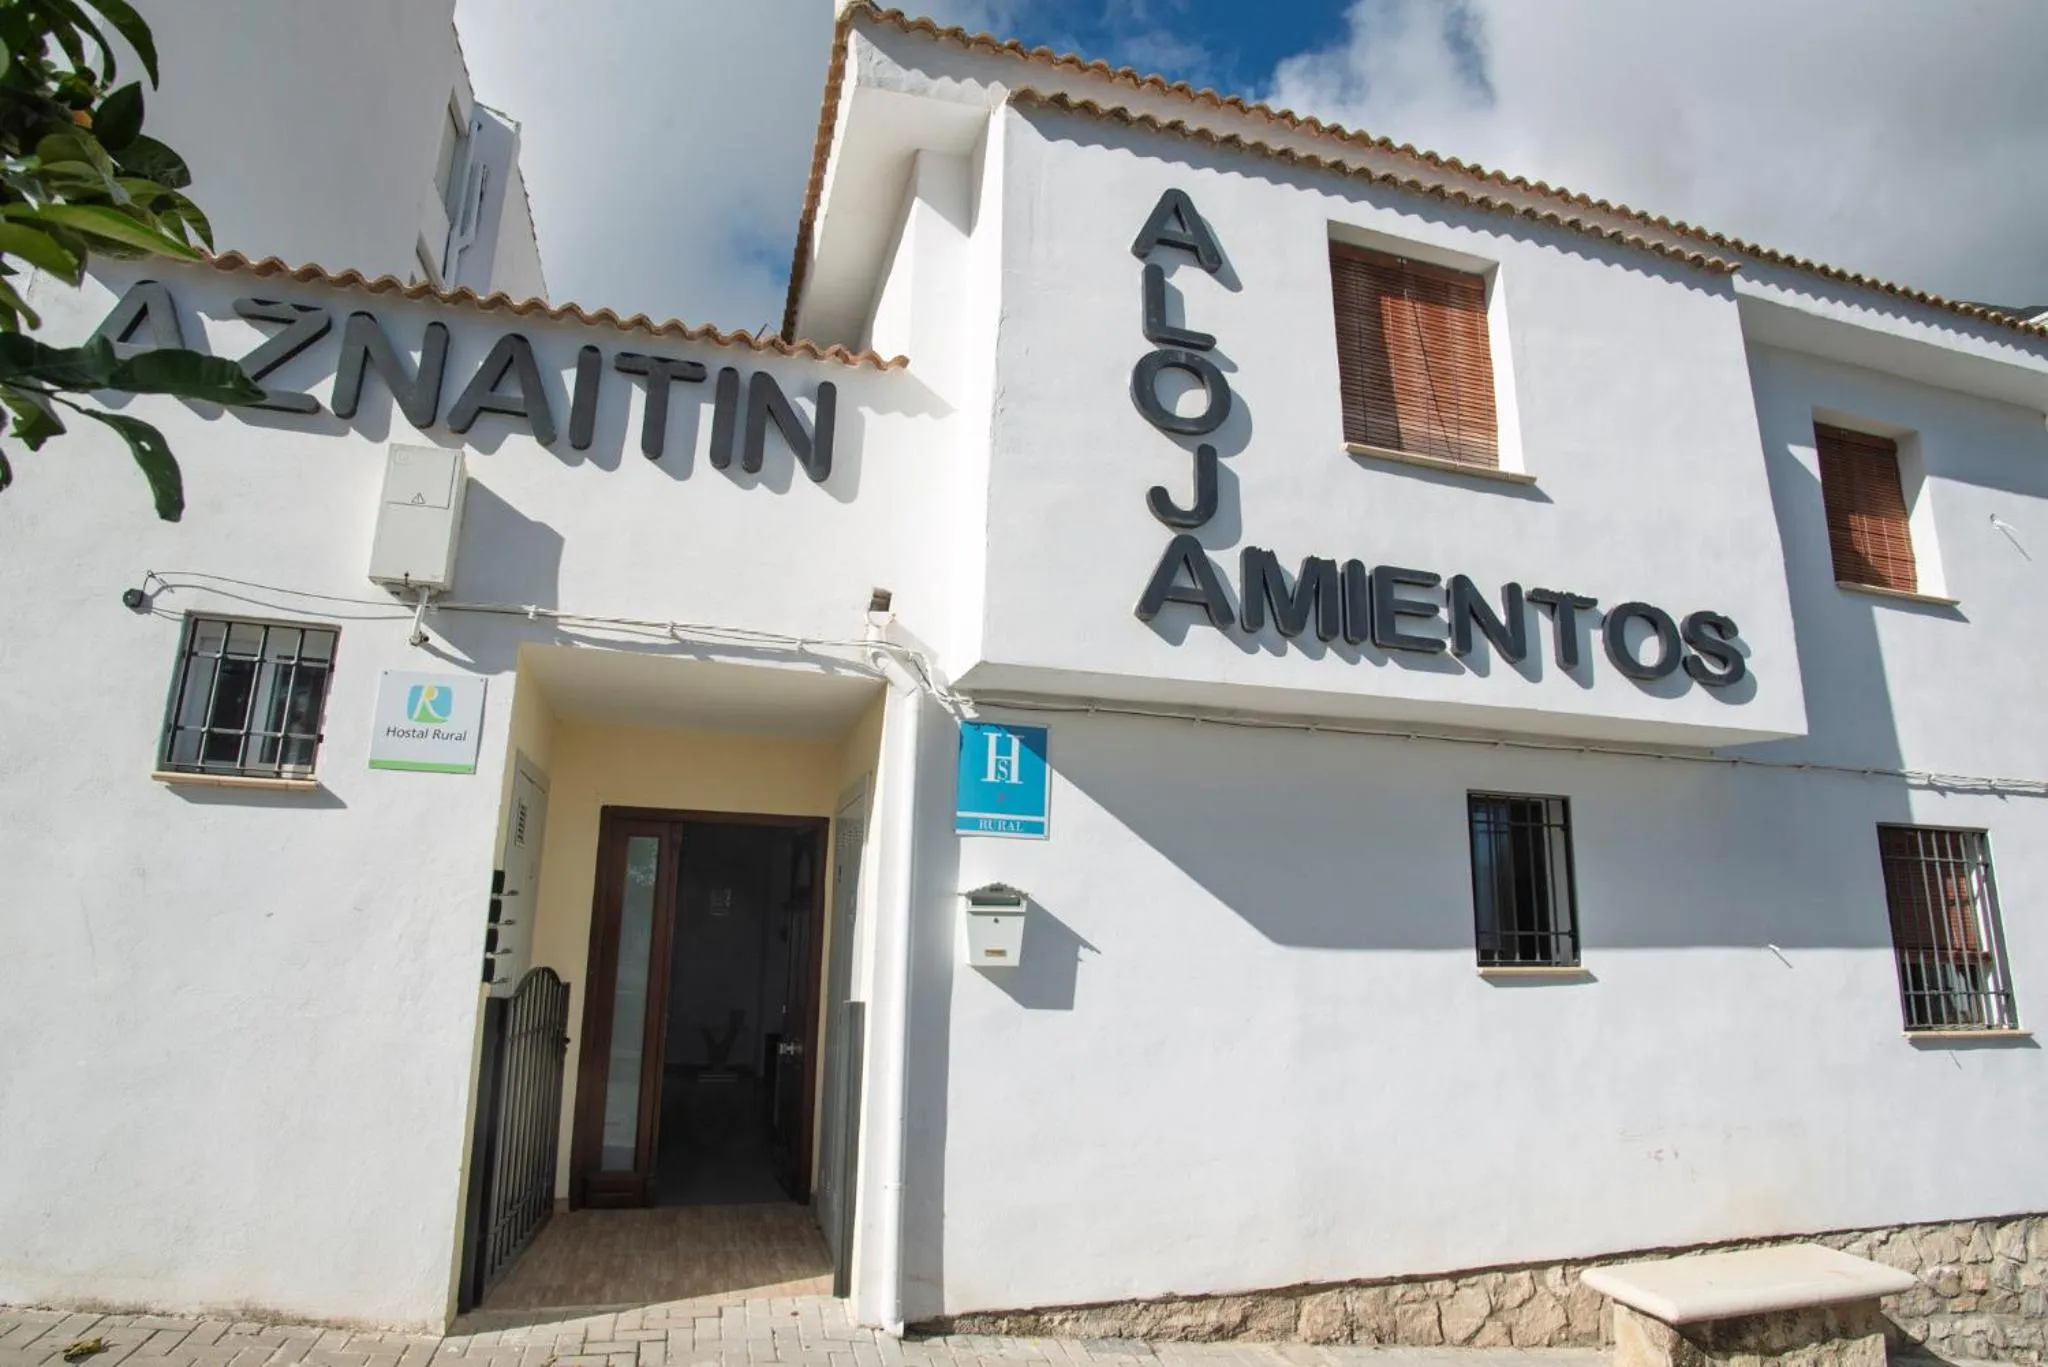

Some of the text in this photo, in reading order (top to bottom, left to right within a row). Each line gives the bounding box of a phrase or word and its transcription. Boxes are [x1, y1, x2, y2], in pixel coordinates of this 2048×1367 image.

[83, 279, 837, 484] AZNAITIN
[385, 726, 467, 742] Hostal Rural
[979, 819, 1025, 832] RURAL
